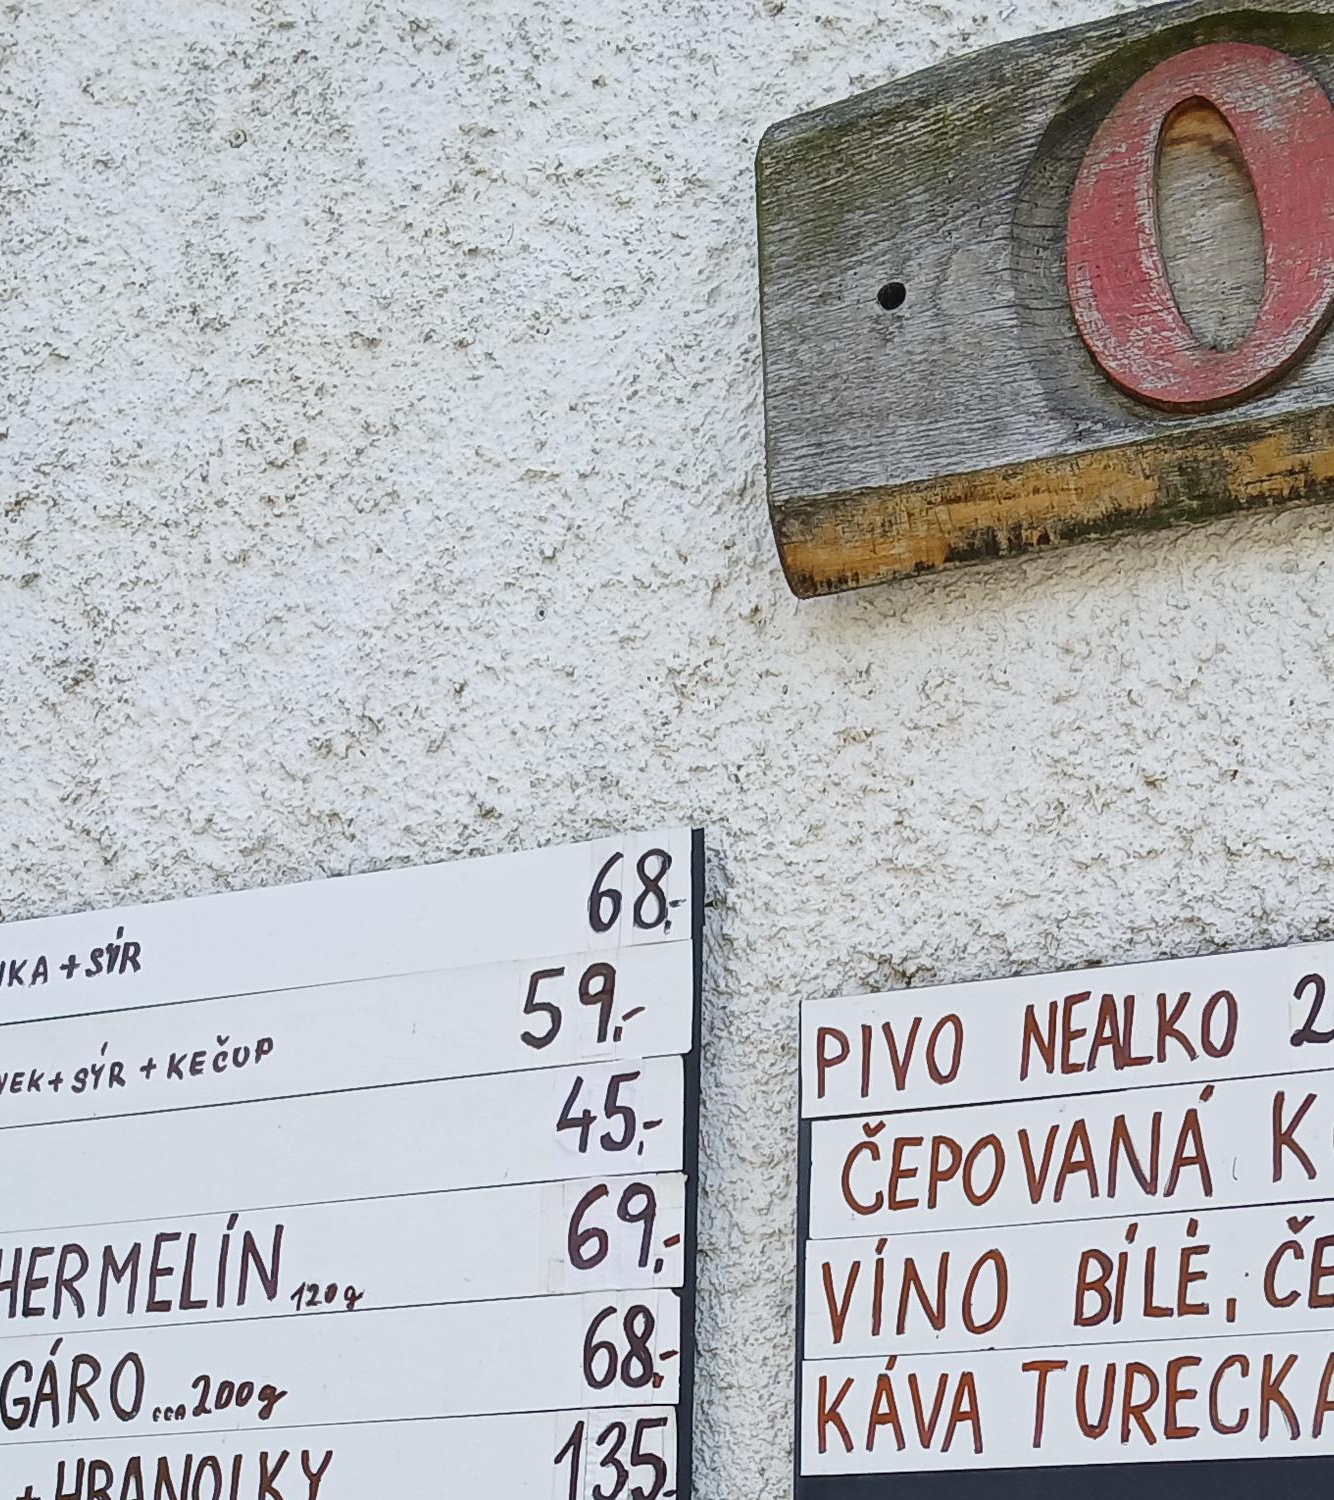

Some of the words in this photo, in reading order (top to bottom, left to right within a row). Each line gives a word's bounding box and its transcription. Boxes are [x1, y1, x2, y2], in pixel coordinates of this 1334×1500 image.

[87, 926, 141, 977] SÝR
[71, 1042, 125, 1093] SÝR
[167, 1035, 273, 1080] KEČUP
[521, 963, 645, 1049] 59,-
[817, 1014, 963, 1099] PIVO
[1020, 990, 1238, 1081] NEALKO
[556, 1071, 663, 1155] 45,-
[842, 1080, 1215, 1215] ČEPOVANÁ
[568, 1182, 680, 1274] 69,-
[822, 1238, 1008, 1344] VÍNO
[817, 1354, 984, 1454] KÁVA
